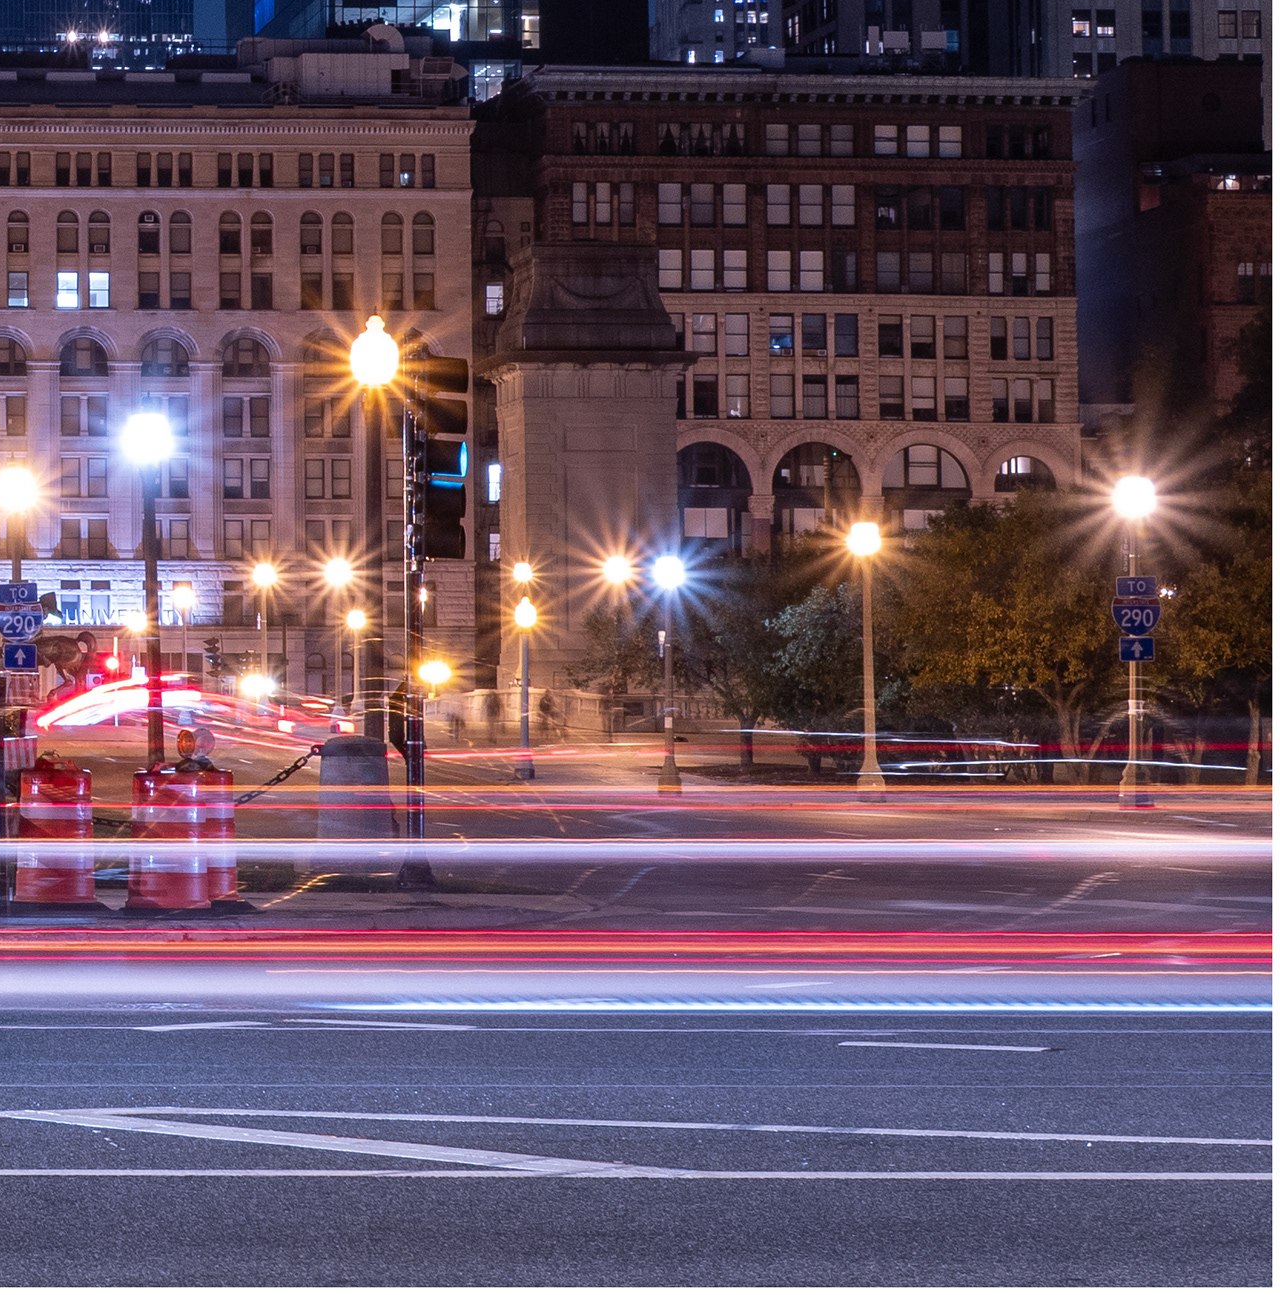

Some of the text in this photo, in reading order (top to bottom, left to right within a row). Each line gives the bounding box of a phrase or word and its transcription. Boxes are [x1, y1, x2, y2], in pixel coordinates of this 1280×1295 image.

[9, 588, 28, 599] TO
[1127, 580, 1147, 592] TO
[3, 615, 35, 634] 290
[1121, 608, 1154, 628] 290
